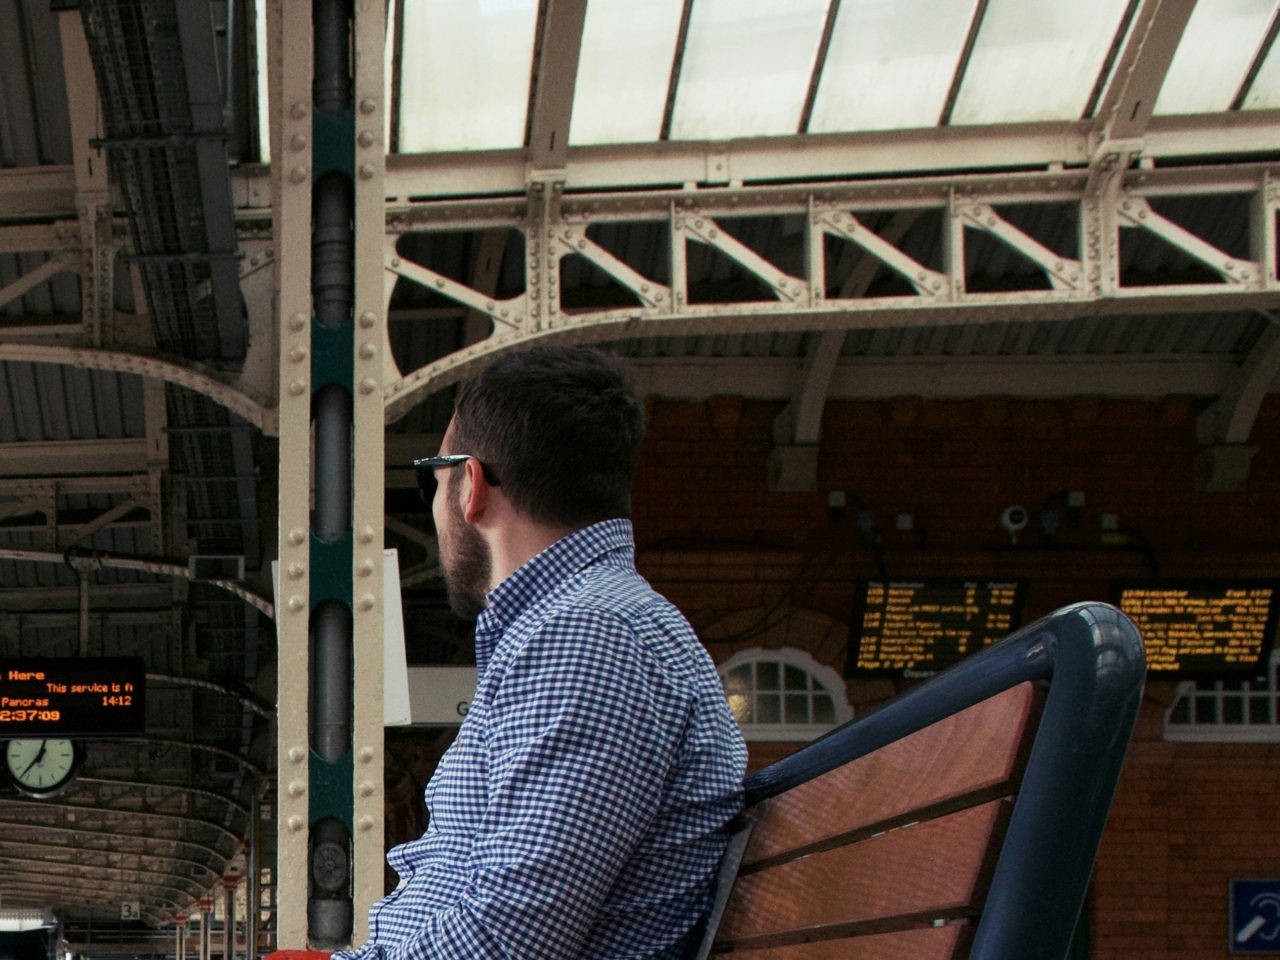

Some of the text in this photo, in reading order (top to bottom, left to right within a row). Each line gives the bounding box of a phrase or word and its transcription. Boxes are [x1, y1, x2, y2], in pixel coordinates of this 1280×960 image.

[8, 671, 45, 681] Here
[46, 682, 67, 693] This
[71, 683, 108, 693] service
[111, 682, 121, 693] is
[1, 697, 49, 708] Pancras
[102, 695, 132, 707] 14:12
[123, 904, 138, 918] 3a
